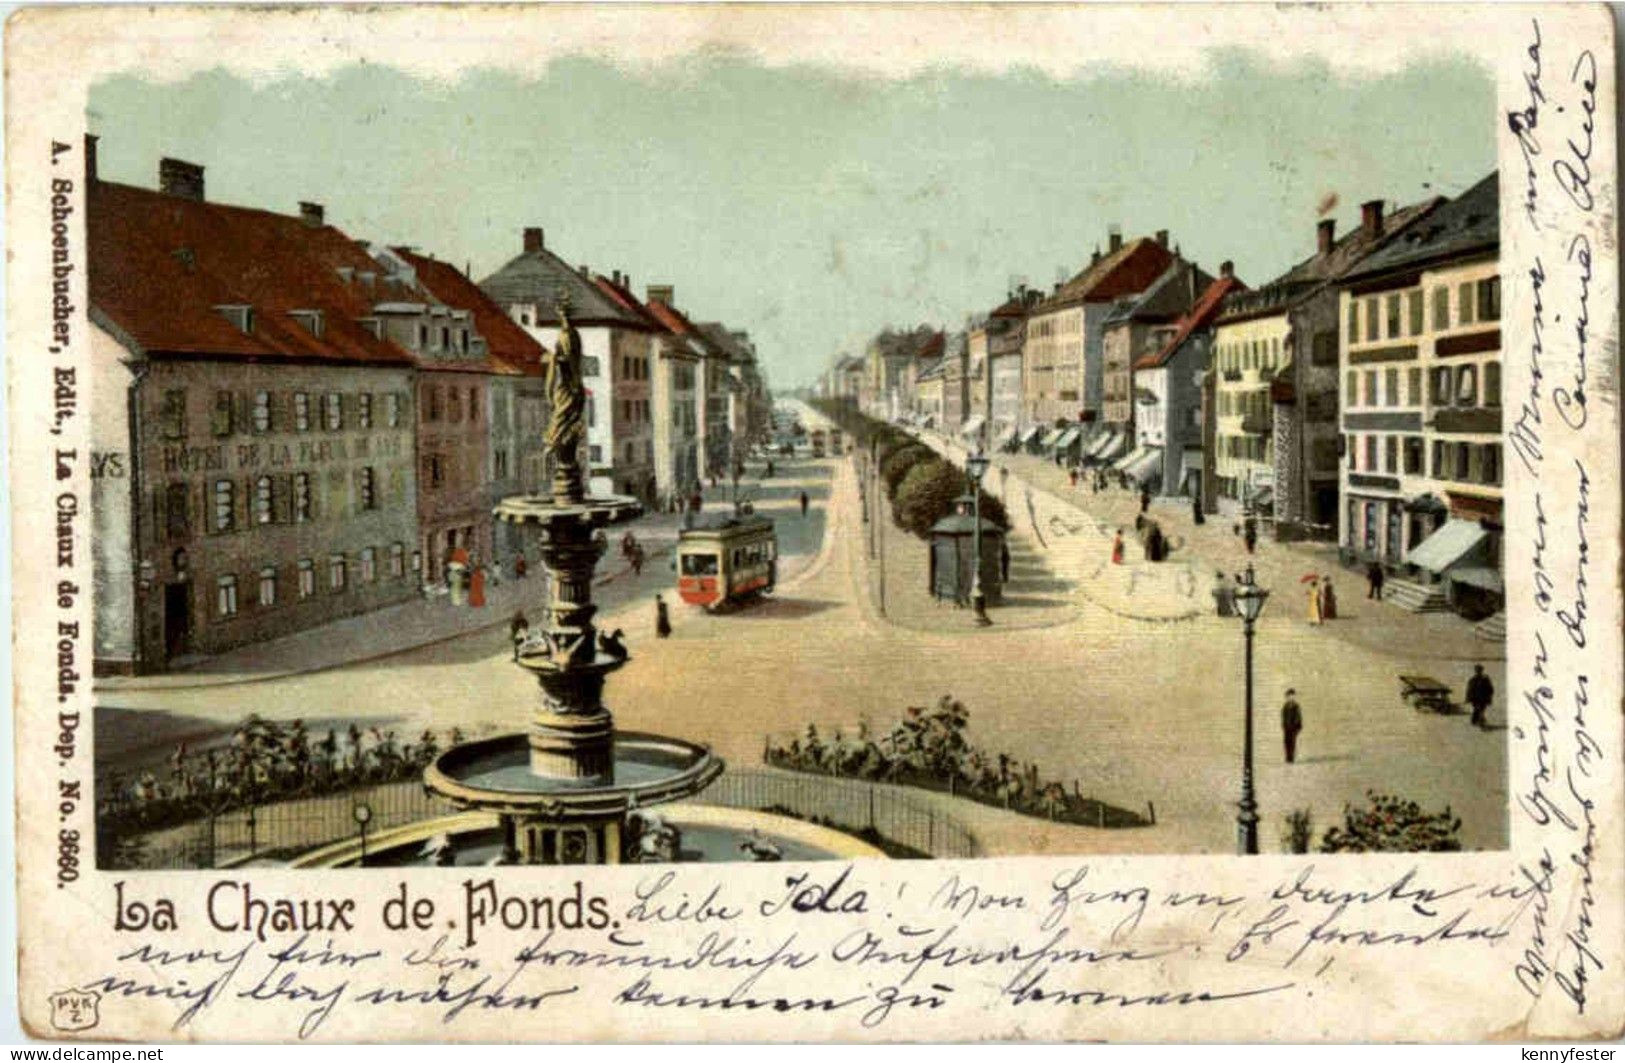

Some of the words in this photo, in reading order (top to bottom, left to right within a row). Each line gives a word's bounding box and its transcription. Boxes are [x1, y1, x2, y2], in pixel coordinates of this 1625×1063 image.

[49, 141, 72, 165] A.
[1551, 49, 1598, 212] Alice
[49, 178, 75, 353] Schoenbucher,
[50, 367, 77, 435] Edit.,
[56, 450, 77, 481] La
[56, 493, 78, 567] Chaux
[57, 580, 80, 609] de
[58, 621, 80, 703] Fonds.
[54, 712, 81, 767] Dep.
[59, 780, 81, 821] No.
[57, 829, 81, 889] 3660.
[113, 879, 179, 932] La
[206, 879, 357, 942] Chaux
[382, 881, 435, 931] de
[626, 871, 743, 922] Liebe
